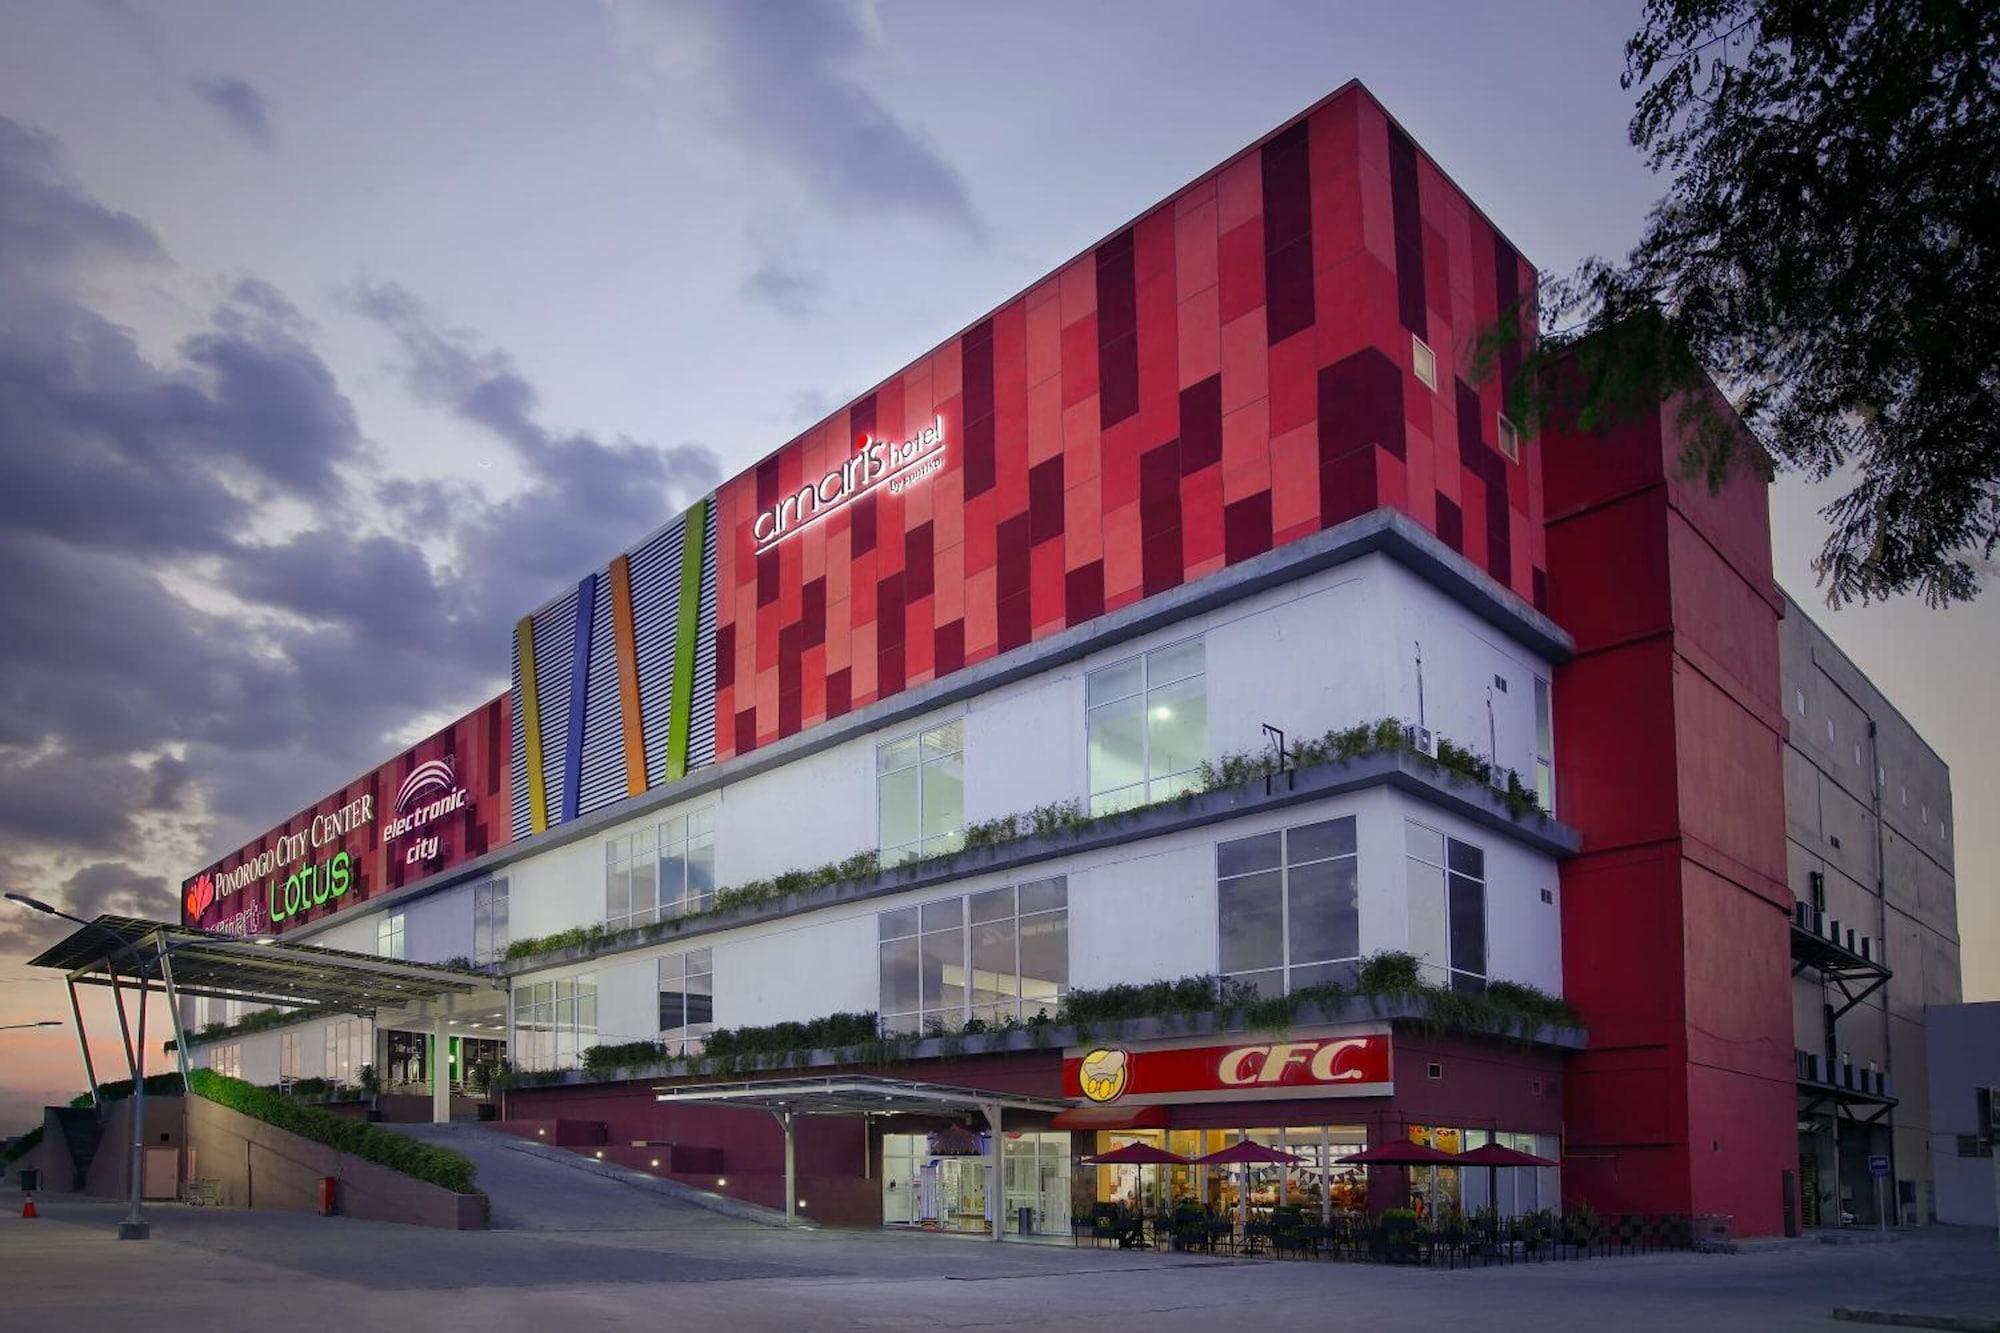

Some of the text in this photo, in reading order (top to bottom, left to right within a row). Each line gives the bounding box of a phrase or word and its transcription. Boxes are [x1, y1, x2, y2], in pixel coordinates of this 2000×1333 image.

[753, 415, 944, 544] amaris hotel
[383, 786, 467, 842] electronic
[215, 793, 374, 901] PONOROGO CITY CENTER
[406, 835, 439, 865] city
[1218, 1038, 1368, 1085] CFC
